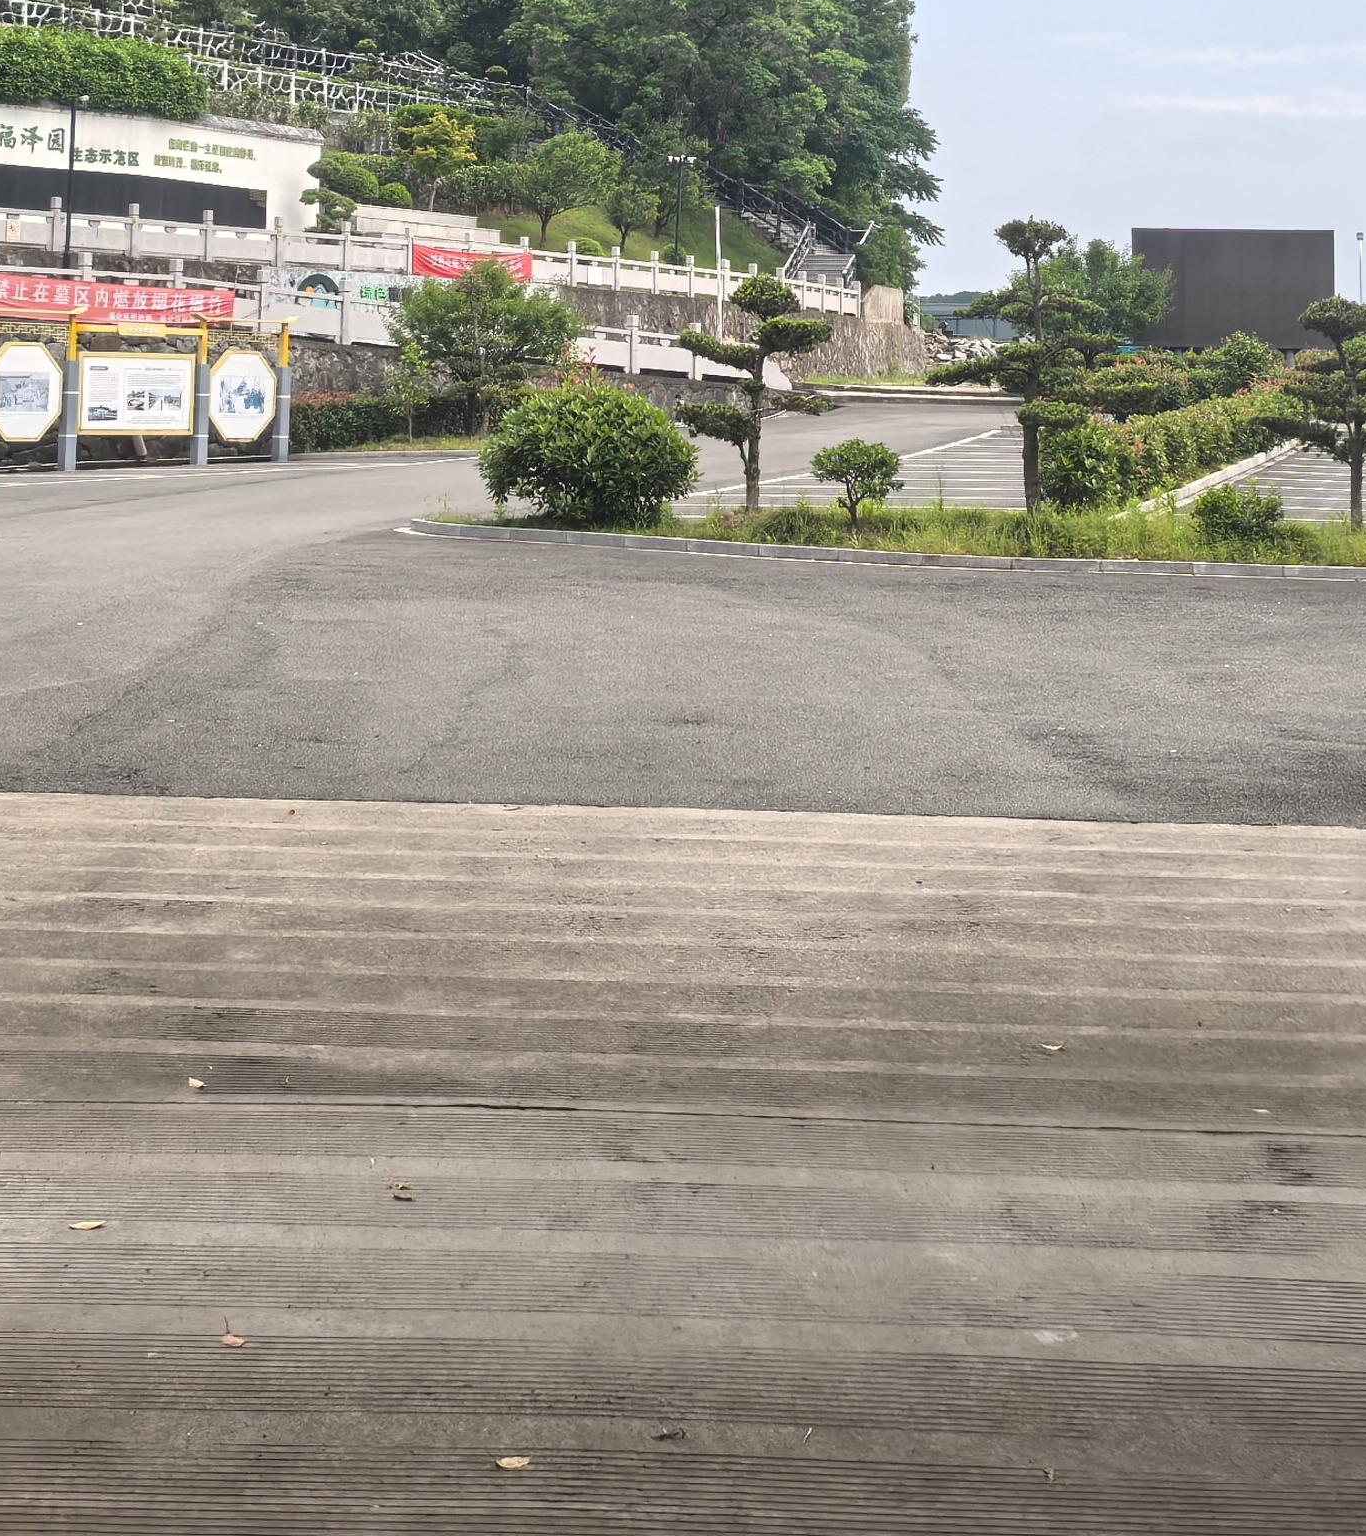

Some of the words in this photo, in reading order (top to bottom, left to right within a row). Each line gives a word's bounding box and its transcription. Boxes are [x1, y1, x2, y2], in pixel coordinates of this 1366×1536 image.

[72, 146, 140, 167] 生态示范区
